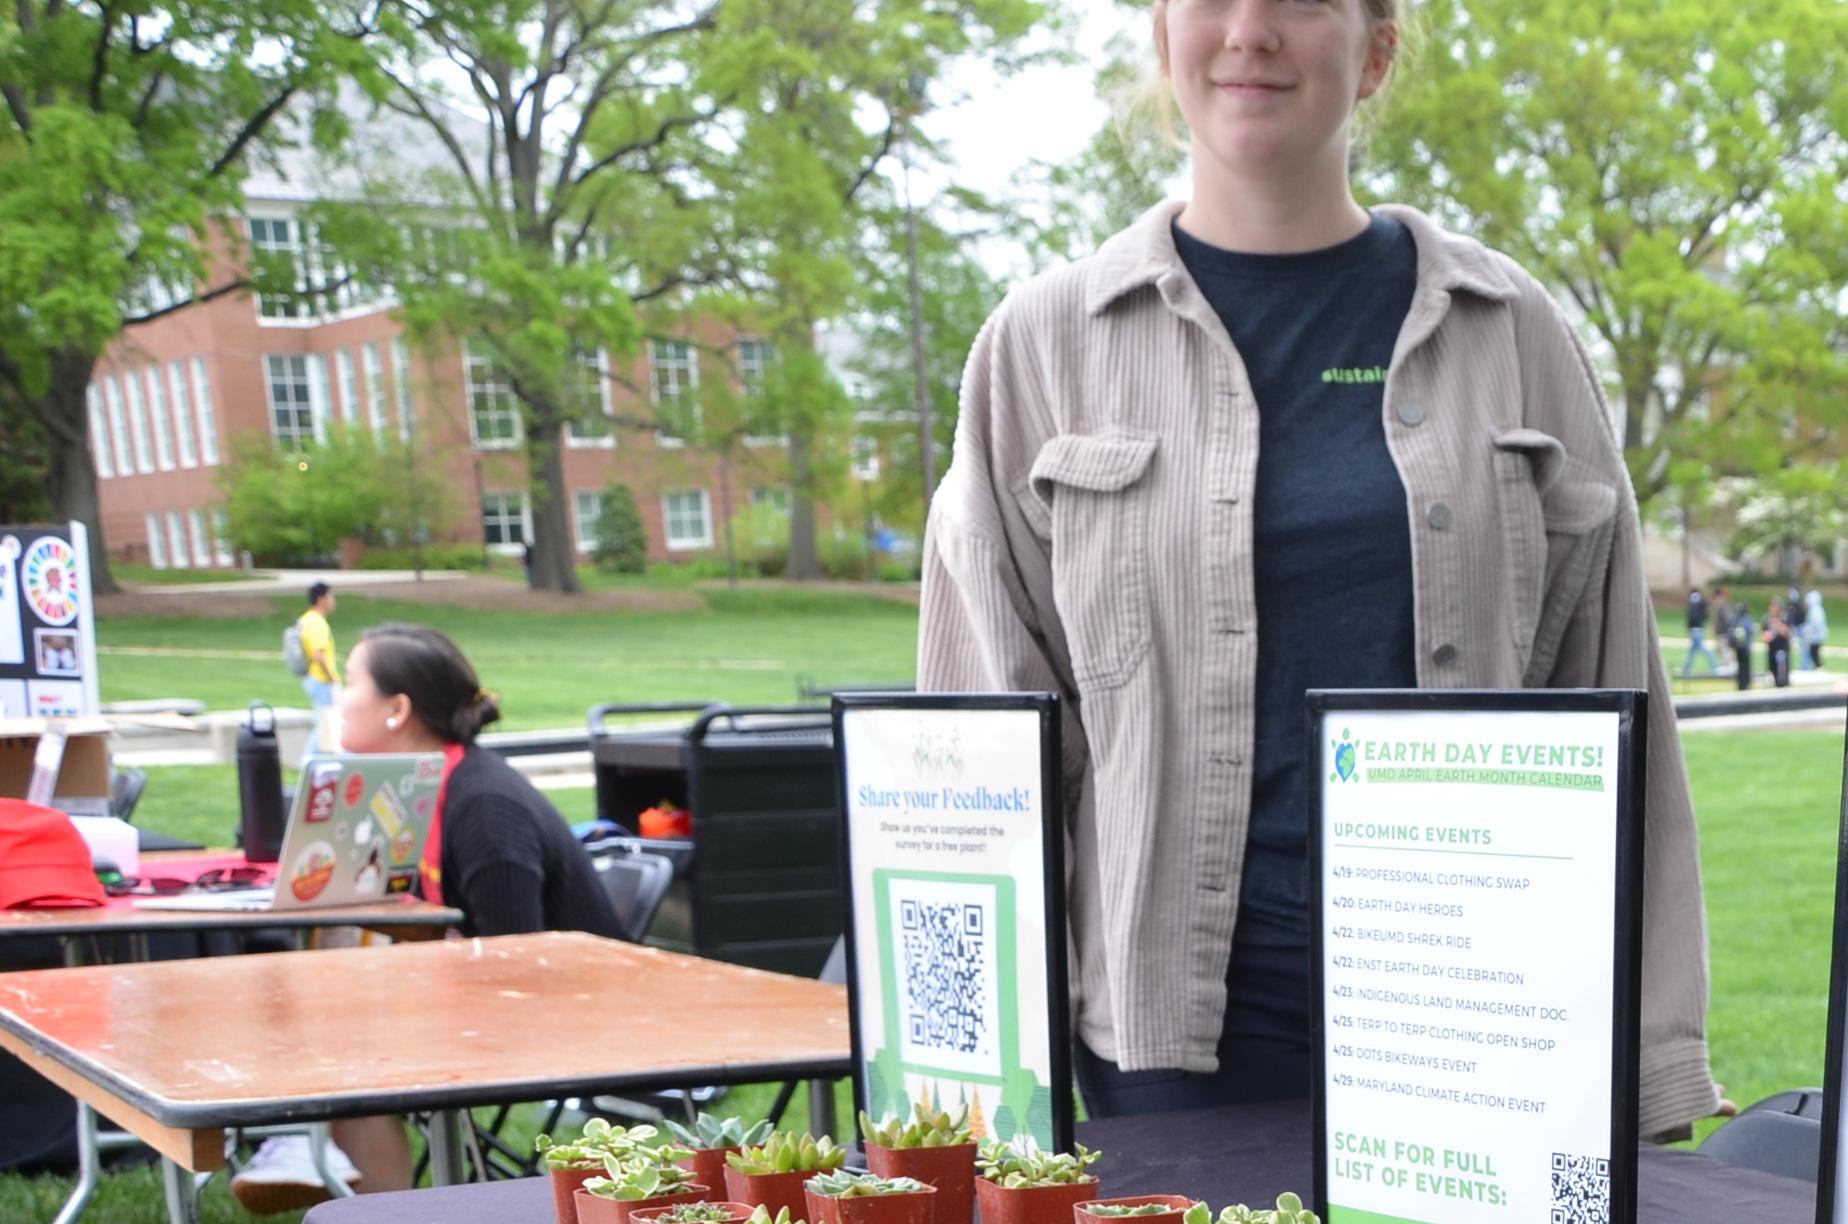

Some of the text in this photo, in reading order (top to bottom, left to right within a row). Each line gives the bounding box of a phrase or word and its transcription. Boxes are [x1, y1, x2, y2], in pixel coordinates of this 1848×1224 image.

[1364, 741, 1604, 767] EARTH DAY EVENTS!
[1369, 768, 1602, 787] UMD APRIL EARTH MONTH CALENDAR
[859, 784, 1030, 815] Share your Feedback!
[880, 821, 899, 832] Show
[902, 824, 910, 833] us
[940, 824, 987, 837] completed
[989, 825, 1004, 836] the
[1334, 822, 1492, 845] UPCOMING EVENTS
[896, 840, 921, 852] survey
[922, 839, 933, 850] for
[942, 841, 957, 852] free
[960, 842, 986, 854] plant!
[1333, 866, 1530, 891] 4/19: PROFESSIONAL CLOTHING SWAP
[1333, 896, 1463, 917] 4/20: EARTH DAY HEROES
[1332, 926, 1471, 950] 4/22: BIKEUMD SHREK RIDE
[1332, 955, 1524, 985] 4/22: ENST EARTH DAY CELEBRATION
[1332, 985, 1570, 1022] 4/23: INDIGENOUS LAND MANAGEMENT DOC.
[1333, 1014, 1556, 1052] 4/25: TERP TO TERP CLOTHING OPEN SHOP
[1333, 1043, 1477, 1074] 4/25: DOTS BIKEWAYS EVENT
[1333, 1073, 1546, 1114] 4/29: MARYLAND CLIMATE ACTION EVENT
[1334, 1131, 1497, 1177] SCAN FOR FULL
[1335, 1157, 1508, 1206] LIST OF EVENTS:
